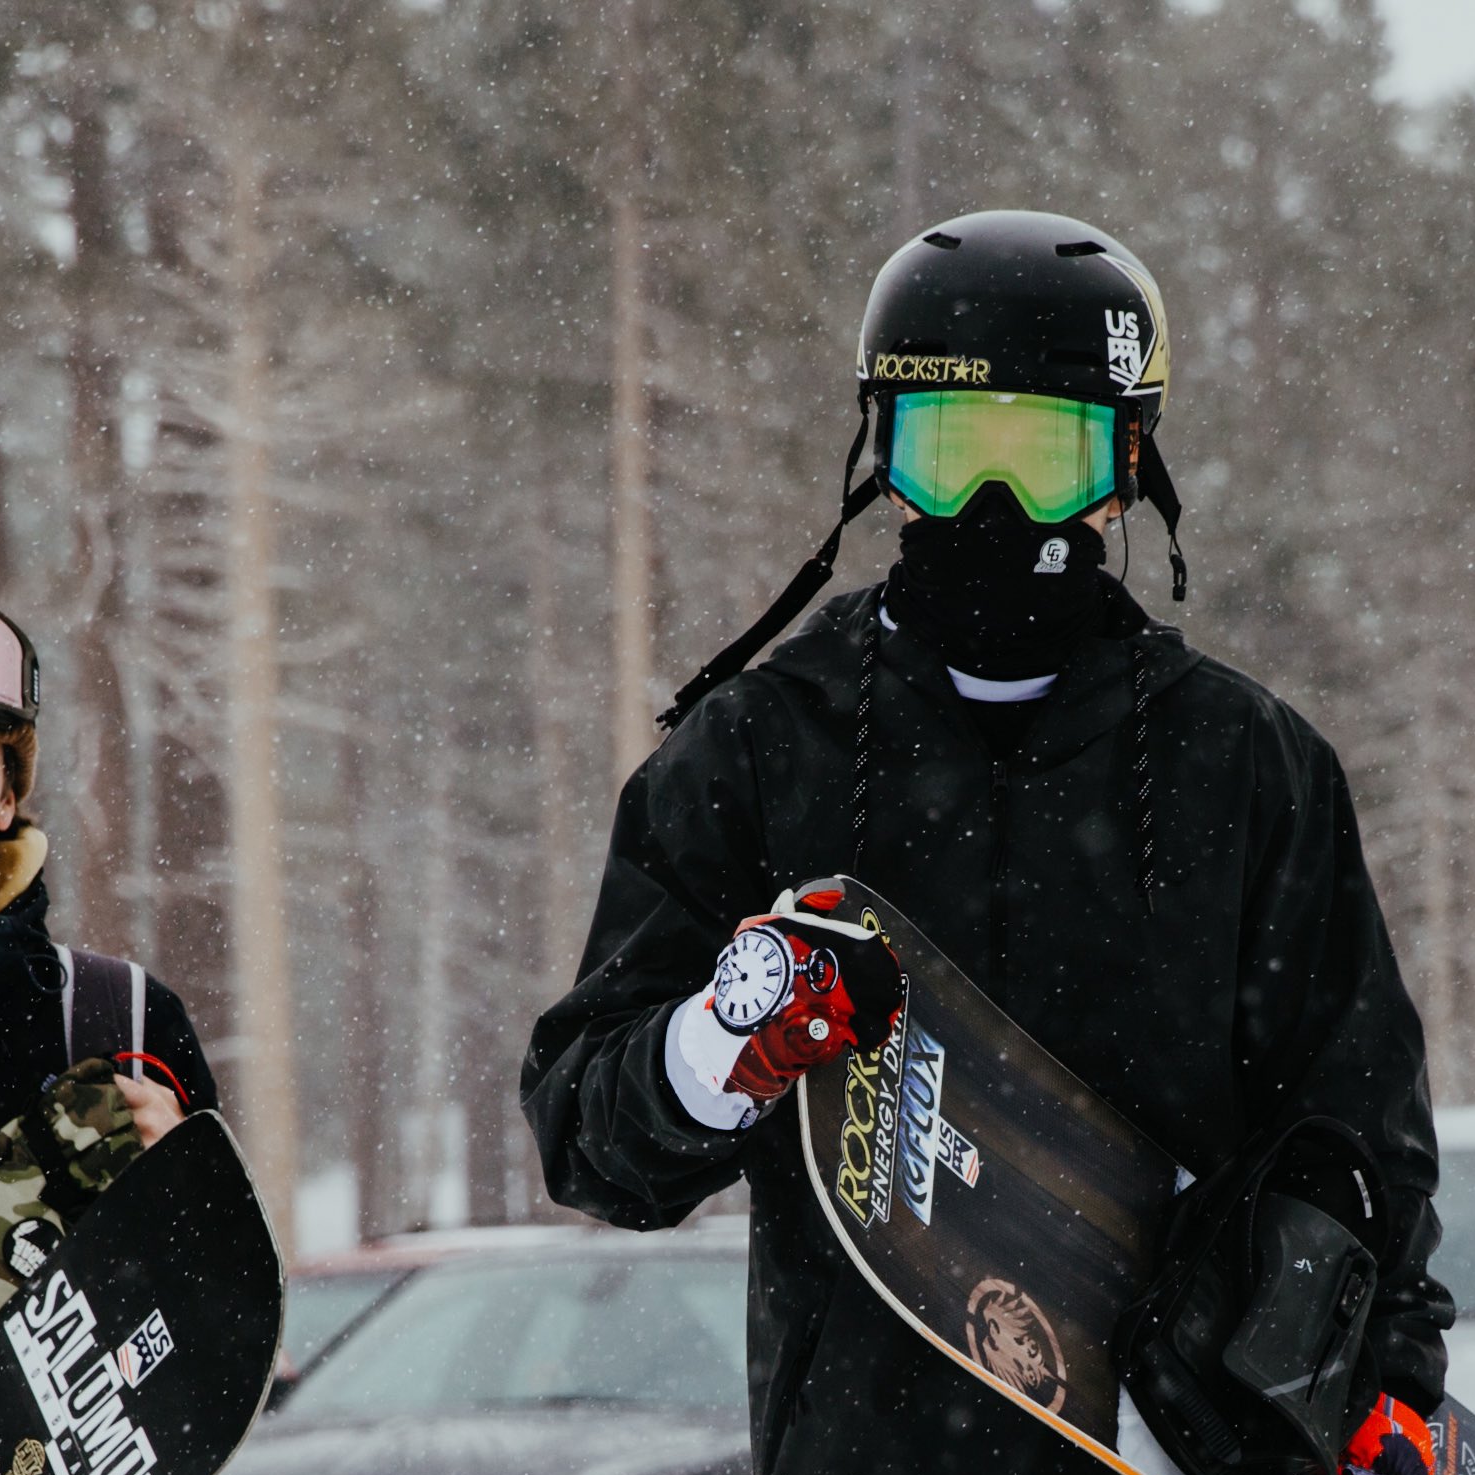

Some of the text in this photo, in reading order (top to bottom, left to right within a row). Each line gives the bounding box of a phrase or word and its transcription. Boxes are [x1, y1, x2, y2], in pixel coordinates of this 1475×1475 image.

[1105, 309, 1139, 339] US
[870, 1077, 895, 1217] ENERGY
[936, 1121, 955, 1163] US
[146, 1313, 171, 1357] US
